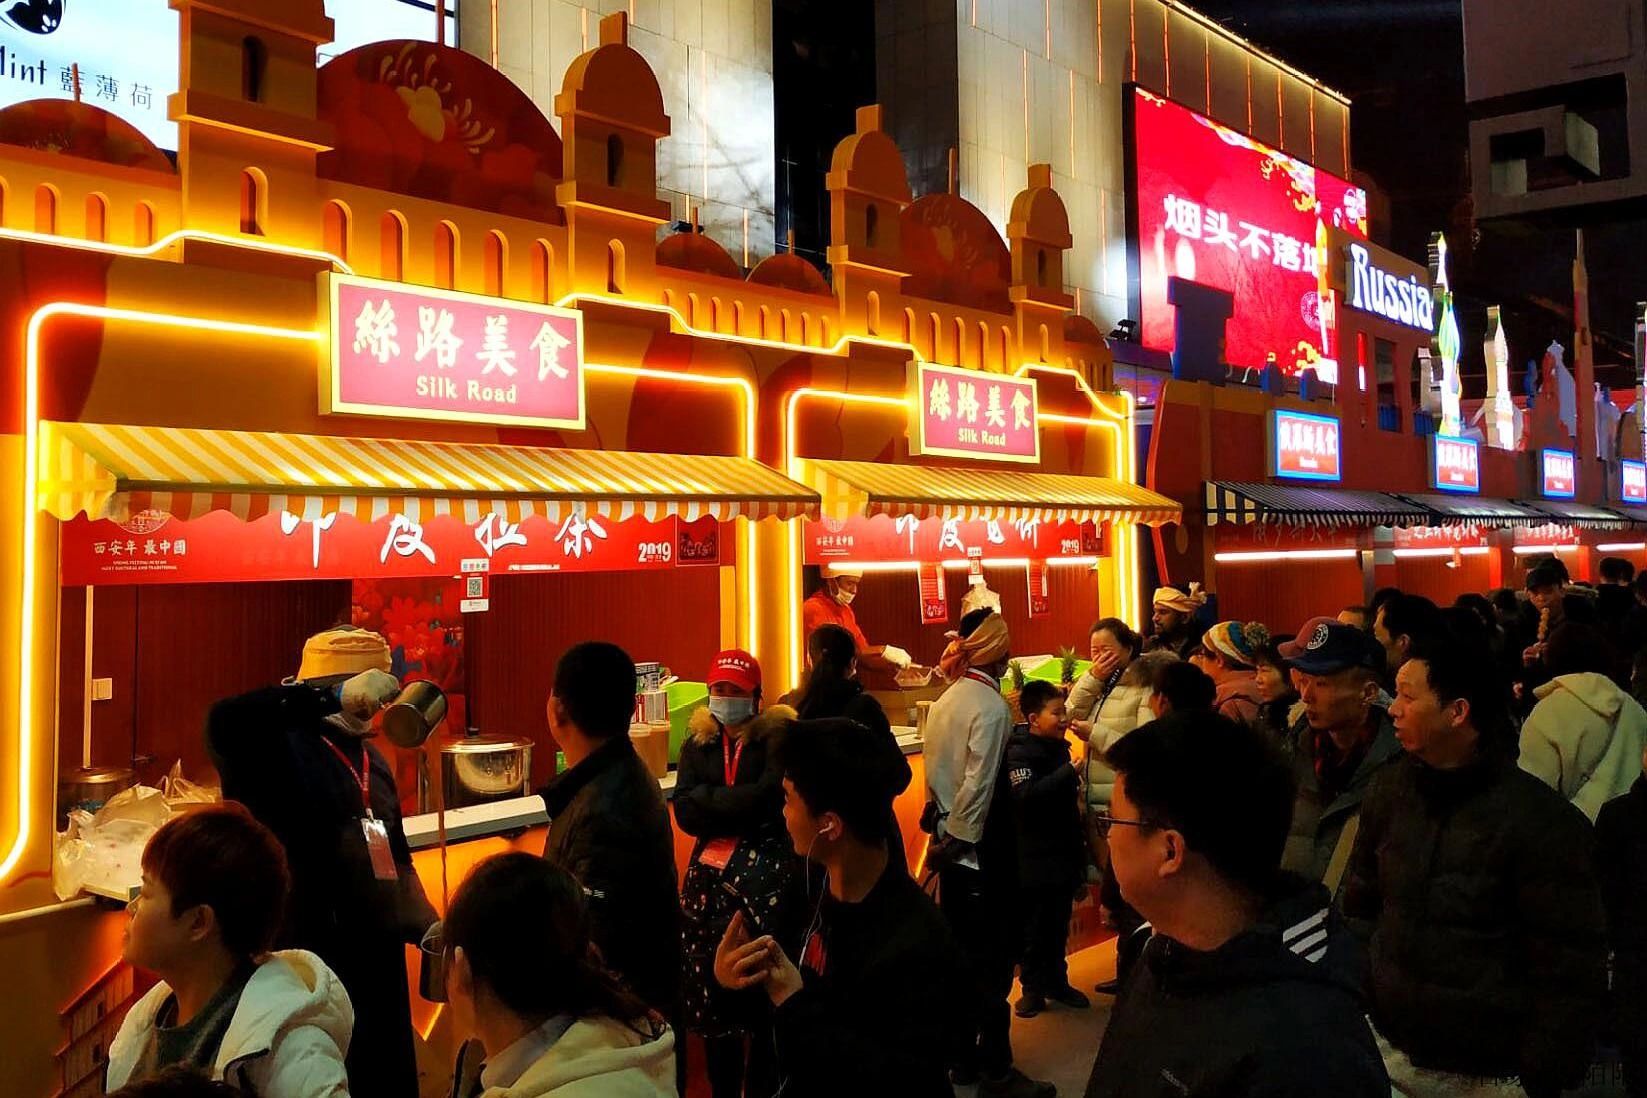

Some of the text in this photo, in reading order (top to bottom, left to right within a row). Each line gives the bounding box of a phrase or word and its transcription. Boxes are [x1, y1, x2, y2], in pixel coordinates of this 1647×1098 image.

[0, 45, 48, 85] int
[1350, 243, 1434, 331] Russia
[353, 299, 572, 381] 絲路美食
[416, 375, 517, 404] Silk Road
[958, 428, 1006, 446] Silk Road
[638, 542, 673, 563] 2019
